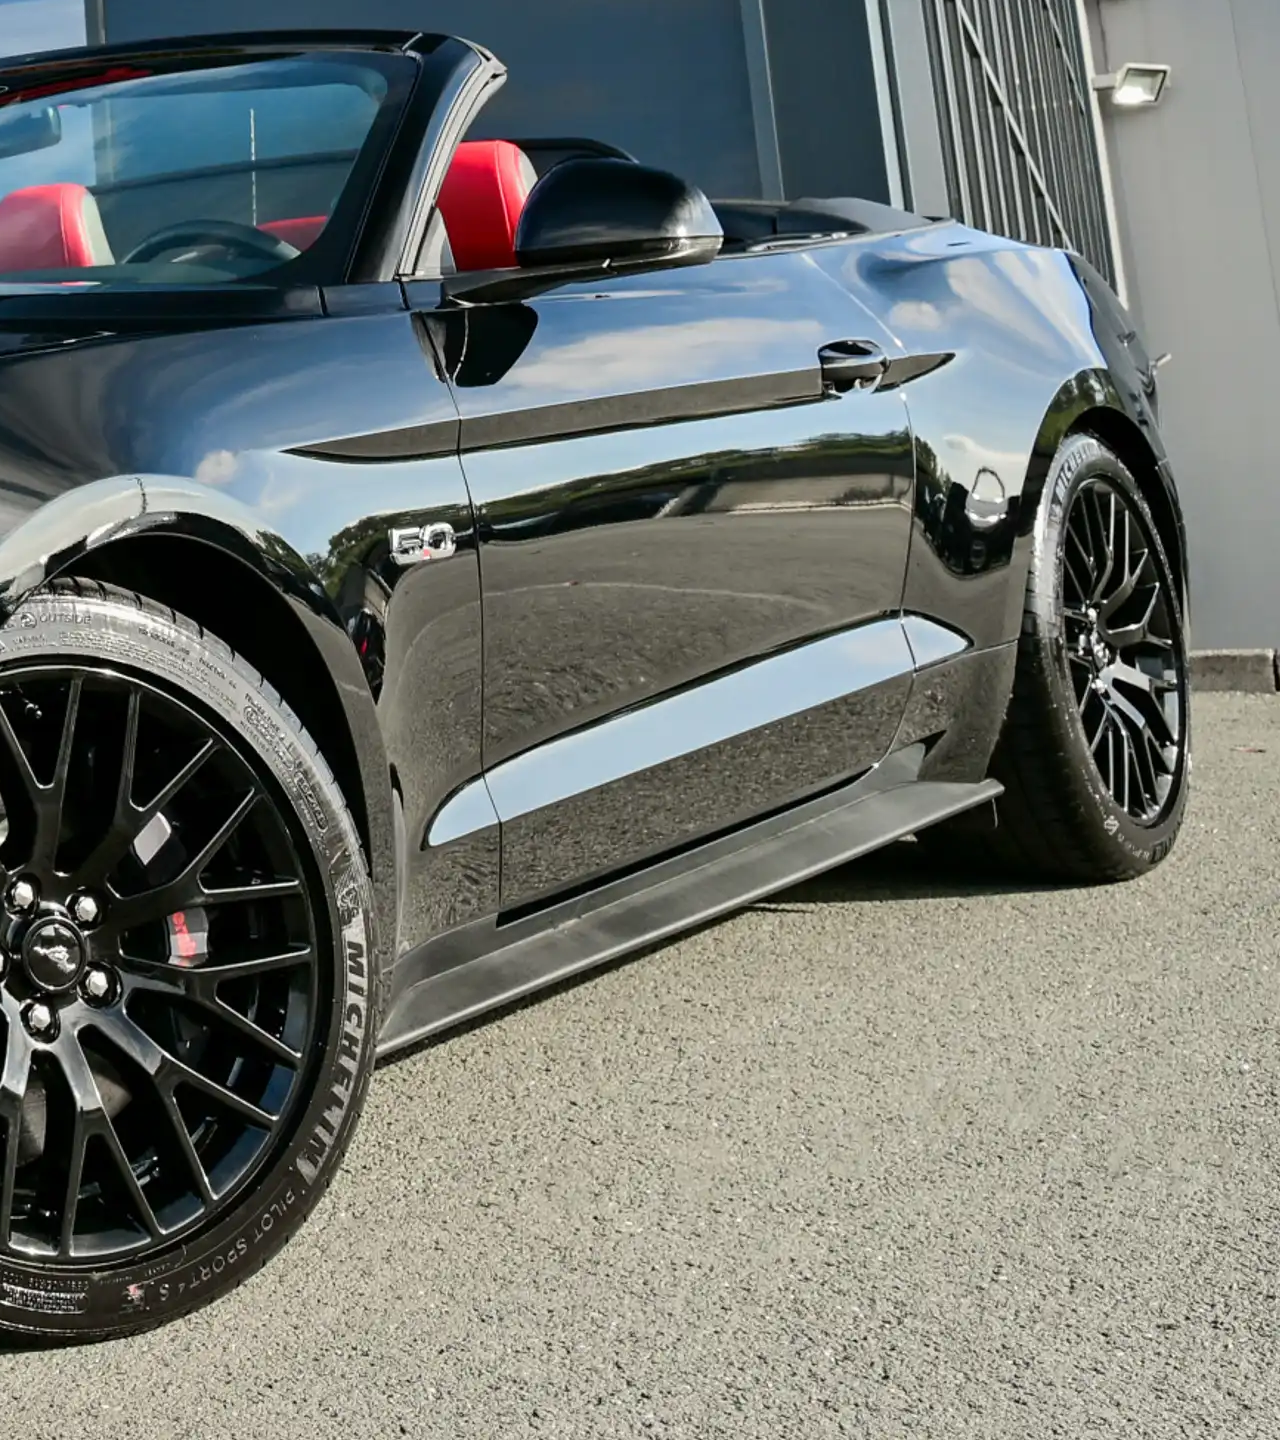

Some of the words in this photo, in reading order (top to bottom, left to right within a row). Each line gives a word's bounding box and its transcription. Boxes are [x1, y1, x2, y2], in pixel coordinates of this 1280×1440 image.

[40, 614, 91, 625] OUTSIDE
[308, 940, 367, 1172] MICHELIN
[253, 1187, 296, 1242] PILOT
[190, 1237, 248, 1289] SPORT
